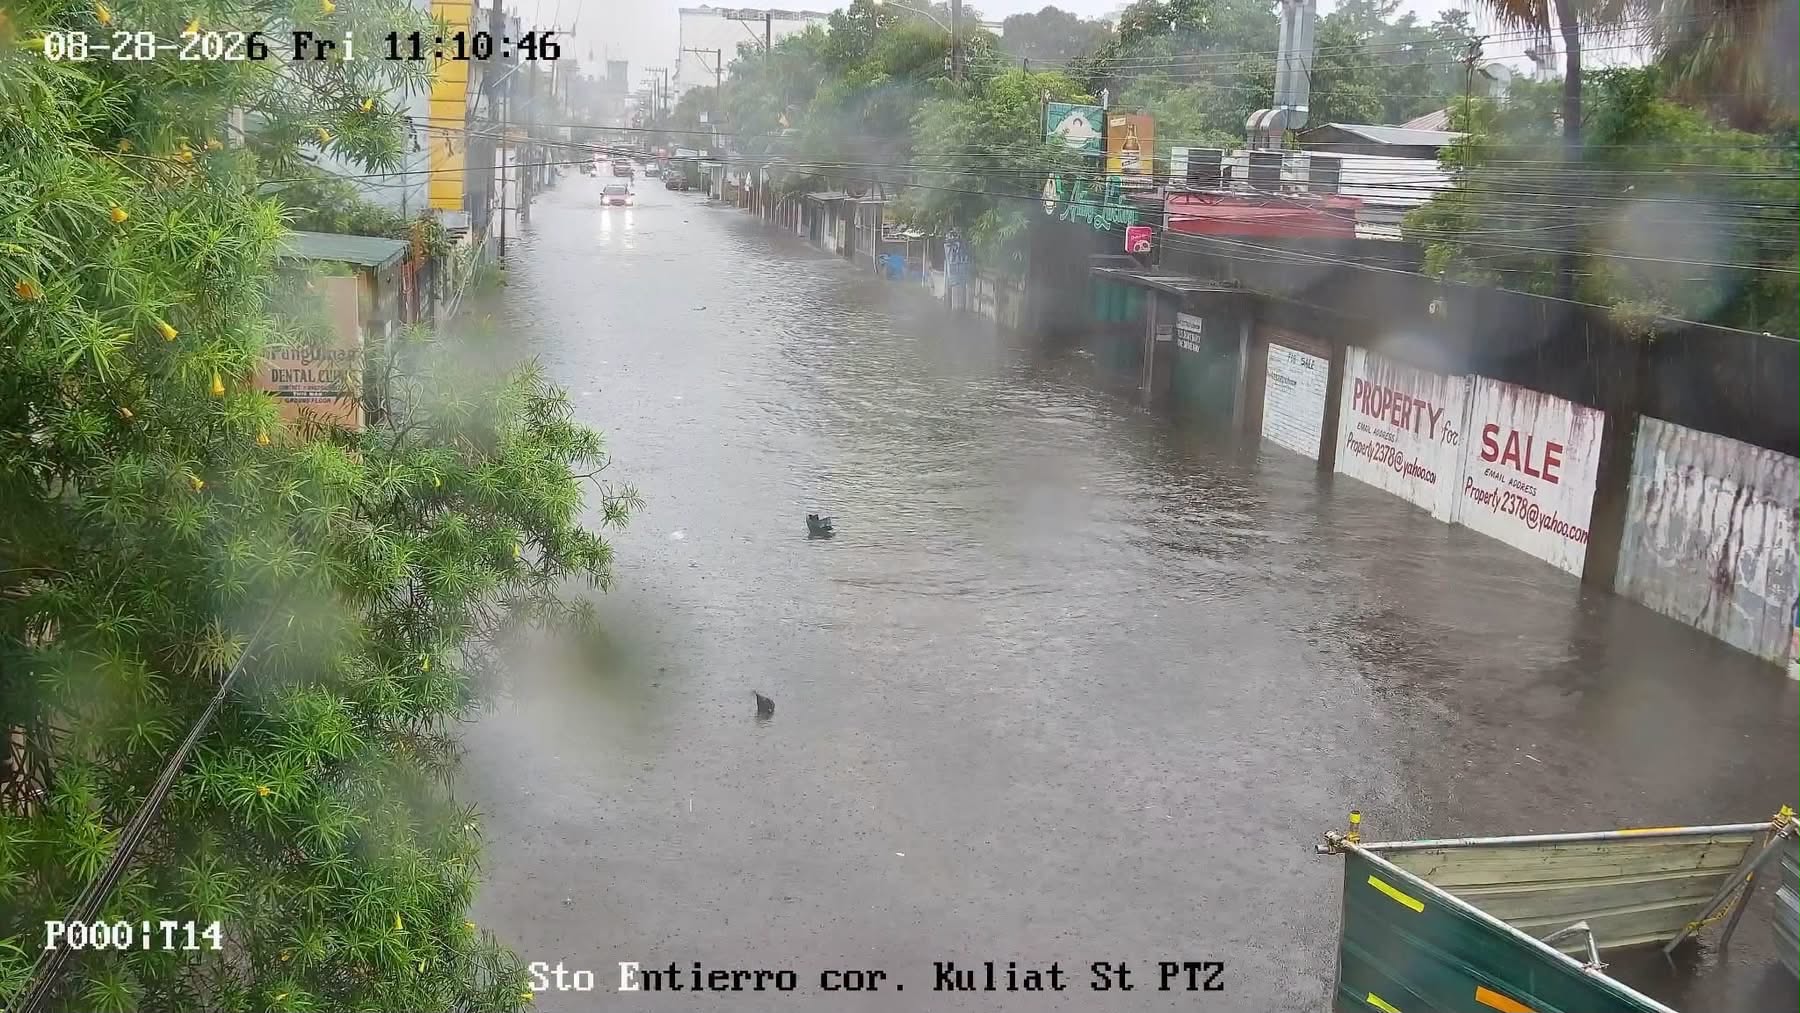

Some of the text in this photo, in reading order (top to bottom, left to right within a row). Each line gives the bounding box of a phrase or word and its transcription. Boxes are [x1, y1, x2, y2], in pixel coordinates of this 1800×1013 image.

[271, 368, 316, 383] DENTAL
[1352, 377, 1459, 447] PROPERTY for
[1356, 422, 1396, 443] EMAIL ADDRESS
[1480, 423, 1564, 485] SALE
[1484, 468, 1537, 496] EMAIL ADDRESS
